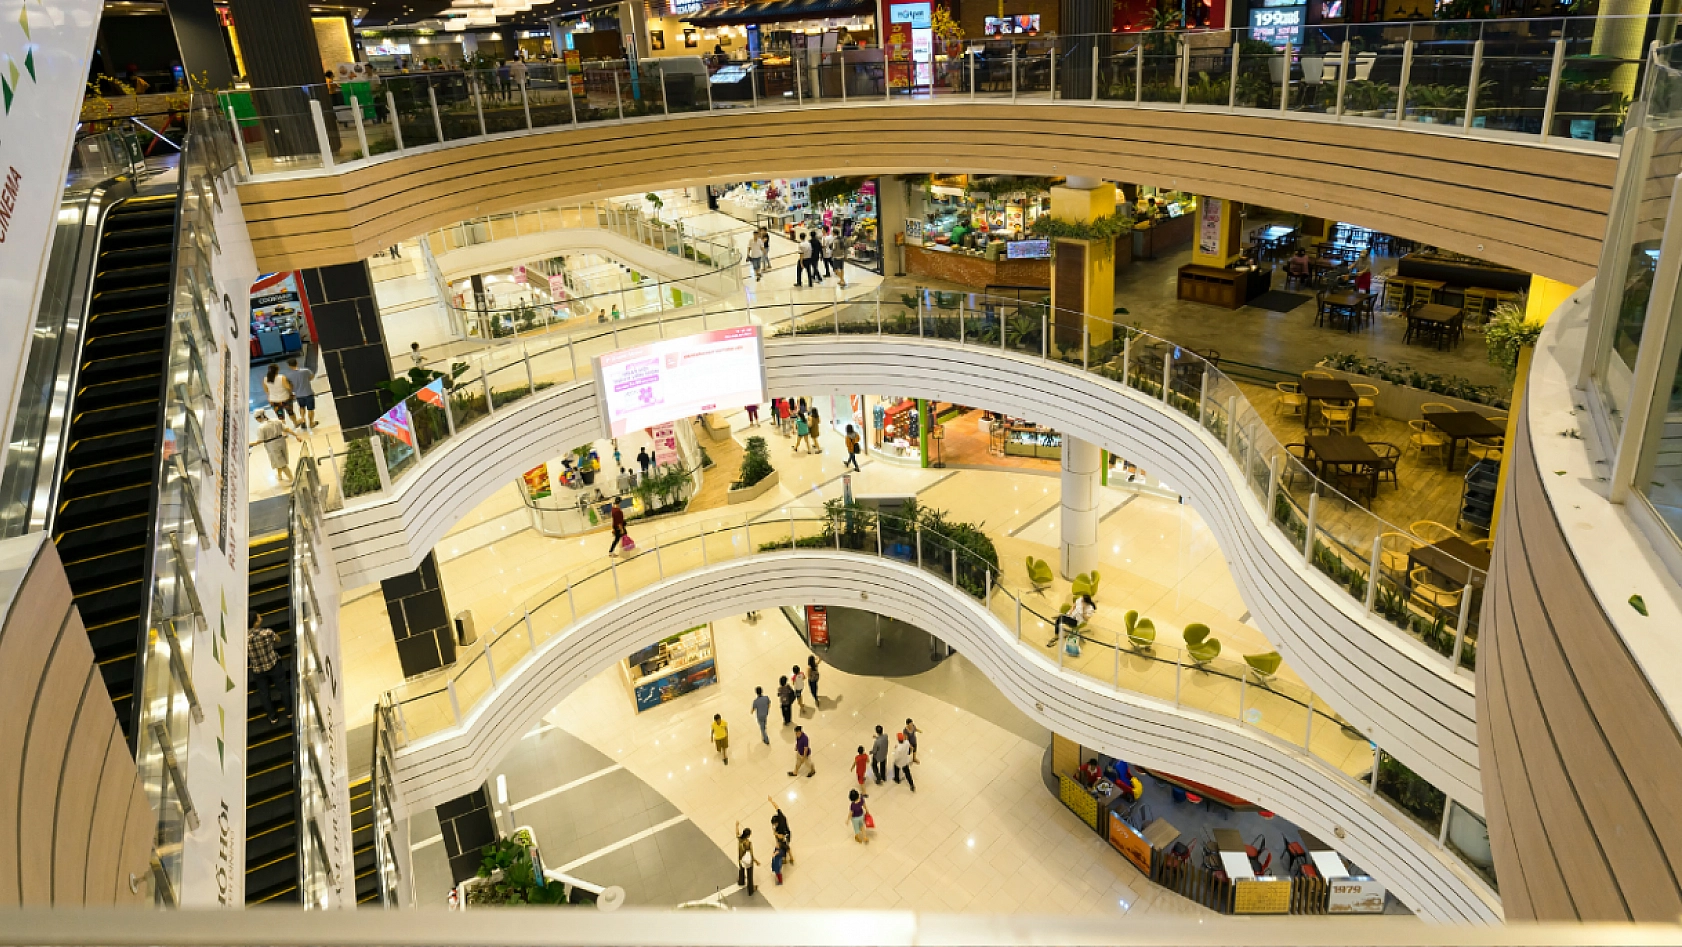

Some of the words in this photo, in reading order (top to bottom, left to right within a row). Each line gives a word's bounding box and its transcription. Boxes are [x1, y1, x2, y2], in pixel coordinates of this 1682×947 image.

[224, 293, 239, 339] 3
[325, 655, 337, 699] 2
[1333, 885, 1362, 894] 1979
